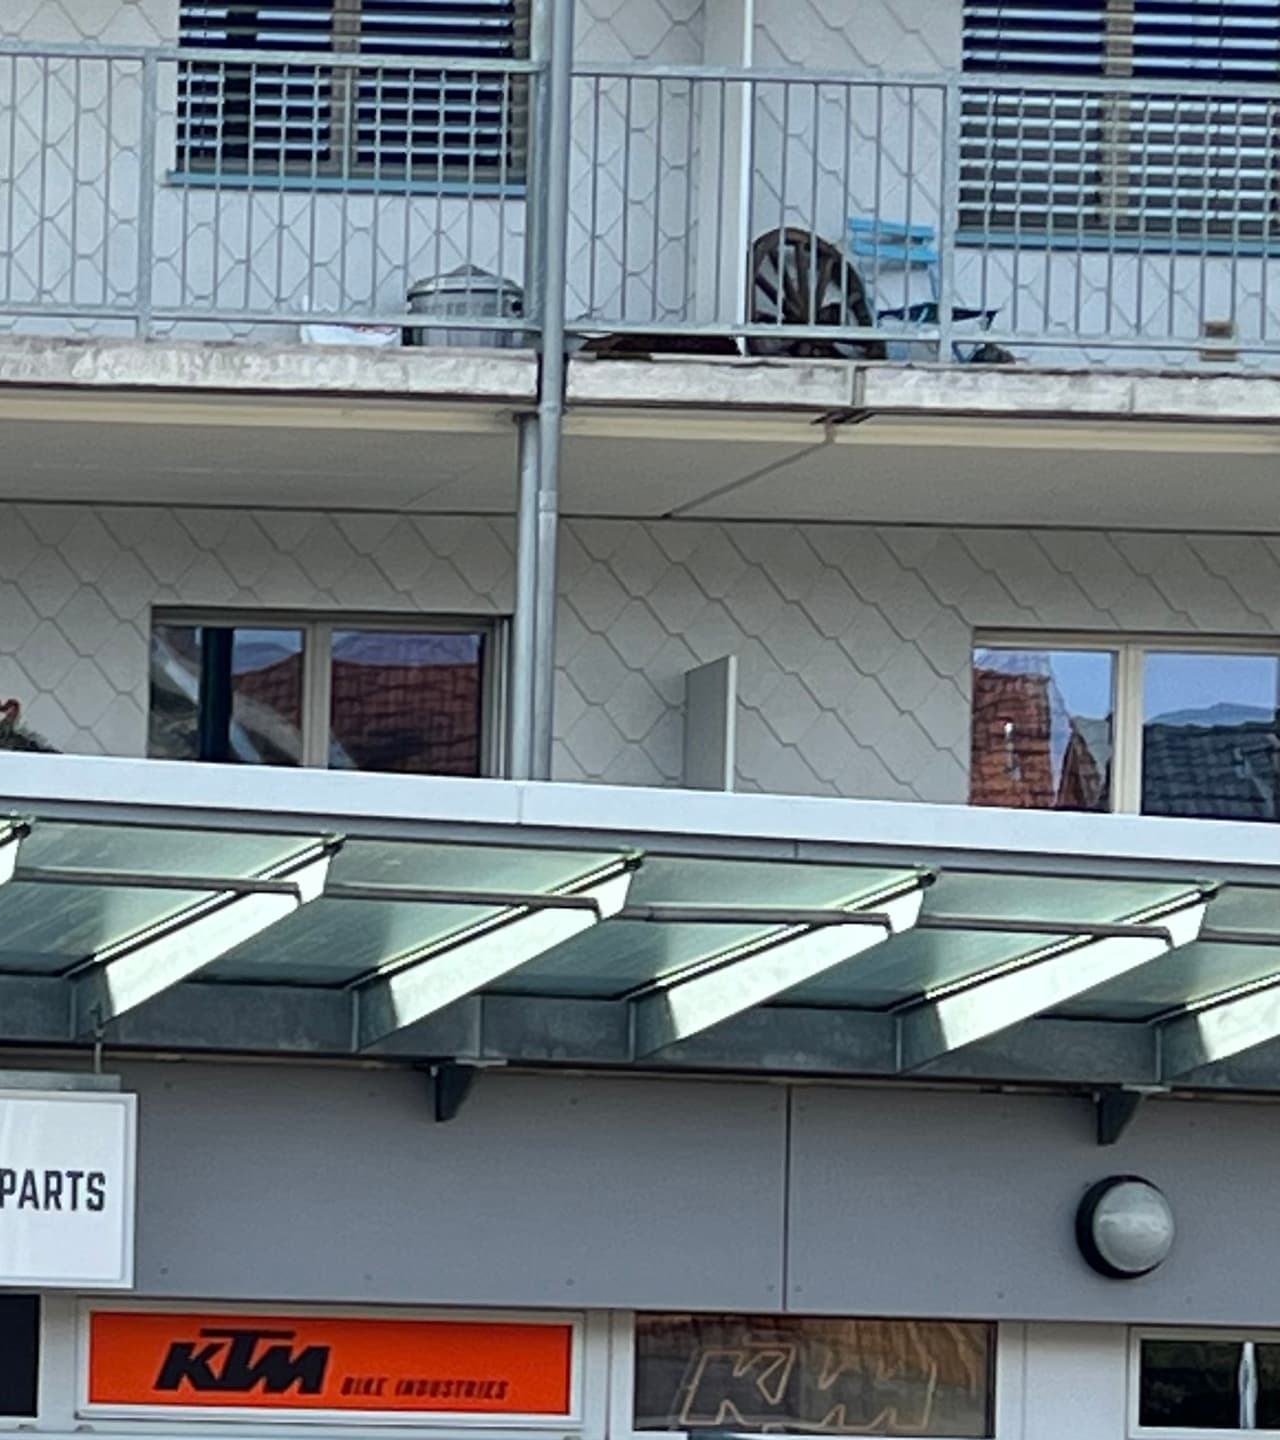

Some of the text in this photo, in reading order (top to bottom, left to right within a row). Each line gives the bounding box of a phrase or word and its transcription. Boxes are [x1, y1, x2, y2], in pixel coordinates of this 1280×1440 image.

[153, 1328, 509, 1400] KTM BIKE INDUSTRIES
